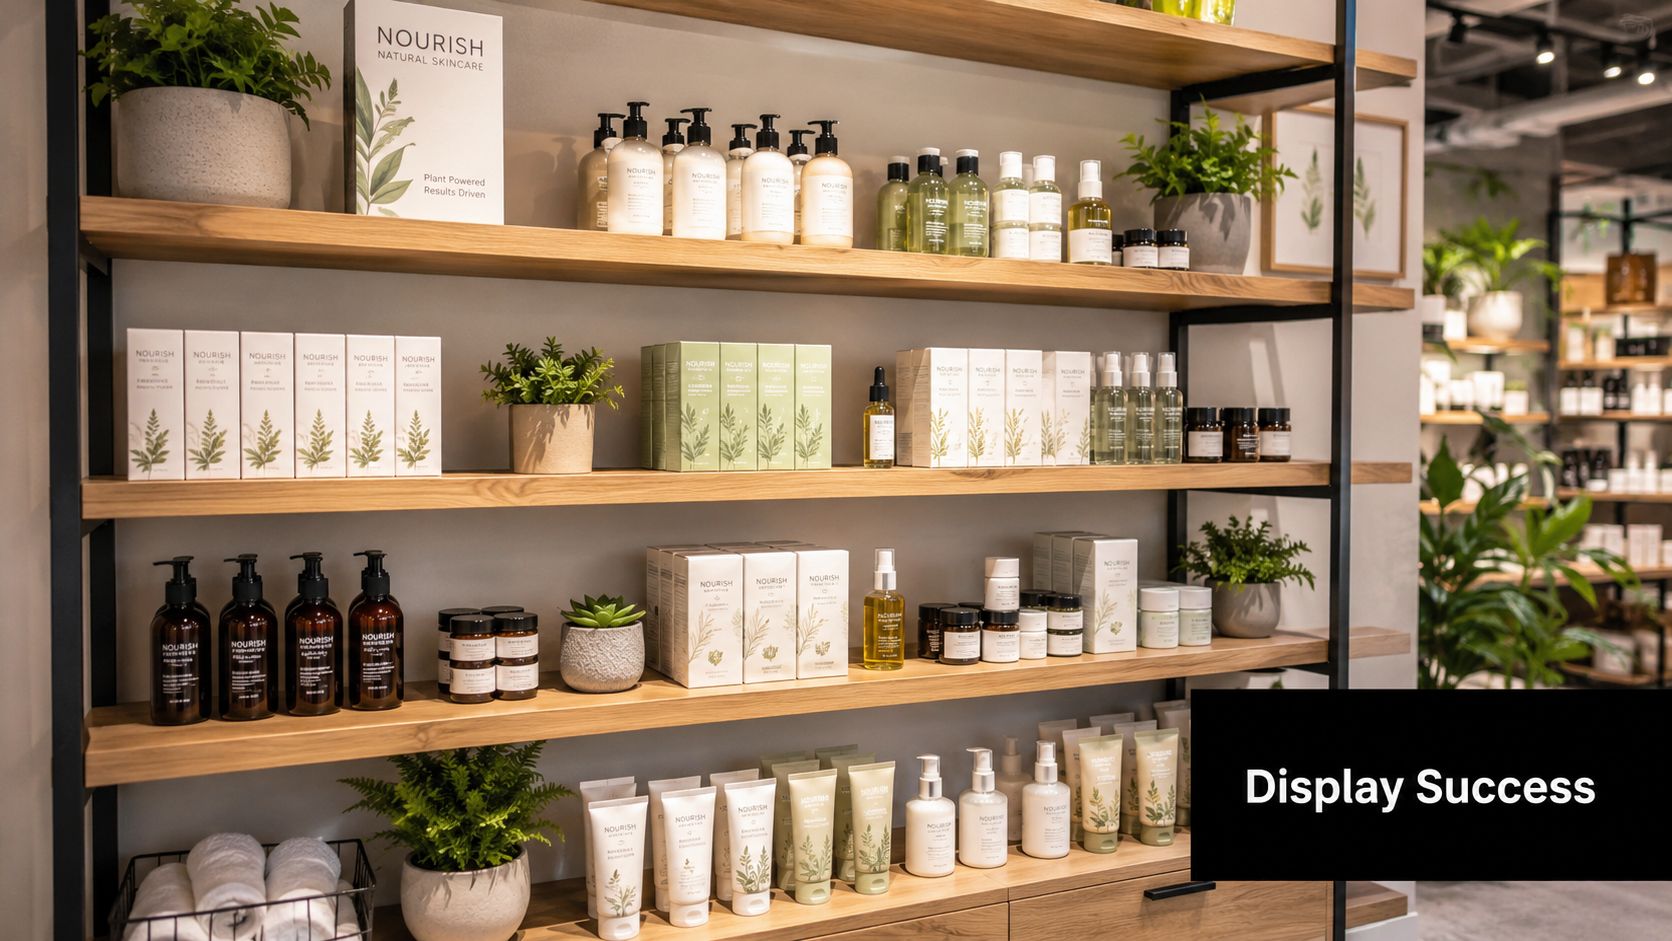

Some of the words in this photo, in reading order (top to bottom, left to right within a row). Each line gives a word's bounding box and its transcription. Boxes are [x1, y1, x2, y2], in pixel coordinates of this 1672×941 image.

[377, 26, 484, 57] NOURISH
[378, 50, 428, 64] NATURAL
[432, 58, 484, 71] SKINCARE
[424, 173, 446, 183] Plant
[448, 176, 486, 187] Powered
[424, 186, 456, 196] Results
[458, 188, 486, 199] Driven
[136, 350, 174, 358] NOURISH
[193, 351, 231, 359] NOURISH
[249, 352, 286, 360] NOURISH
[303, 353, 338, 361] NOURISH
[354, 354, 388, 362] NOURISH
[299, 636, 334, 644] NOURISH
[362, 632, 394, 640] NOURISH
[162, 643, 198, 651] NOURISH
[231, 640, 266, 648] NOURISH
[738, 804, 768, 814] NOURISH
[675, 814, 706, 823] NOURISH
[604, 824, 636, 832] NOURISH
